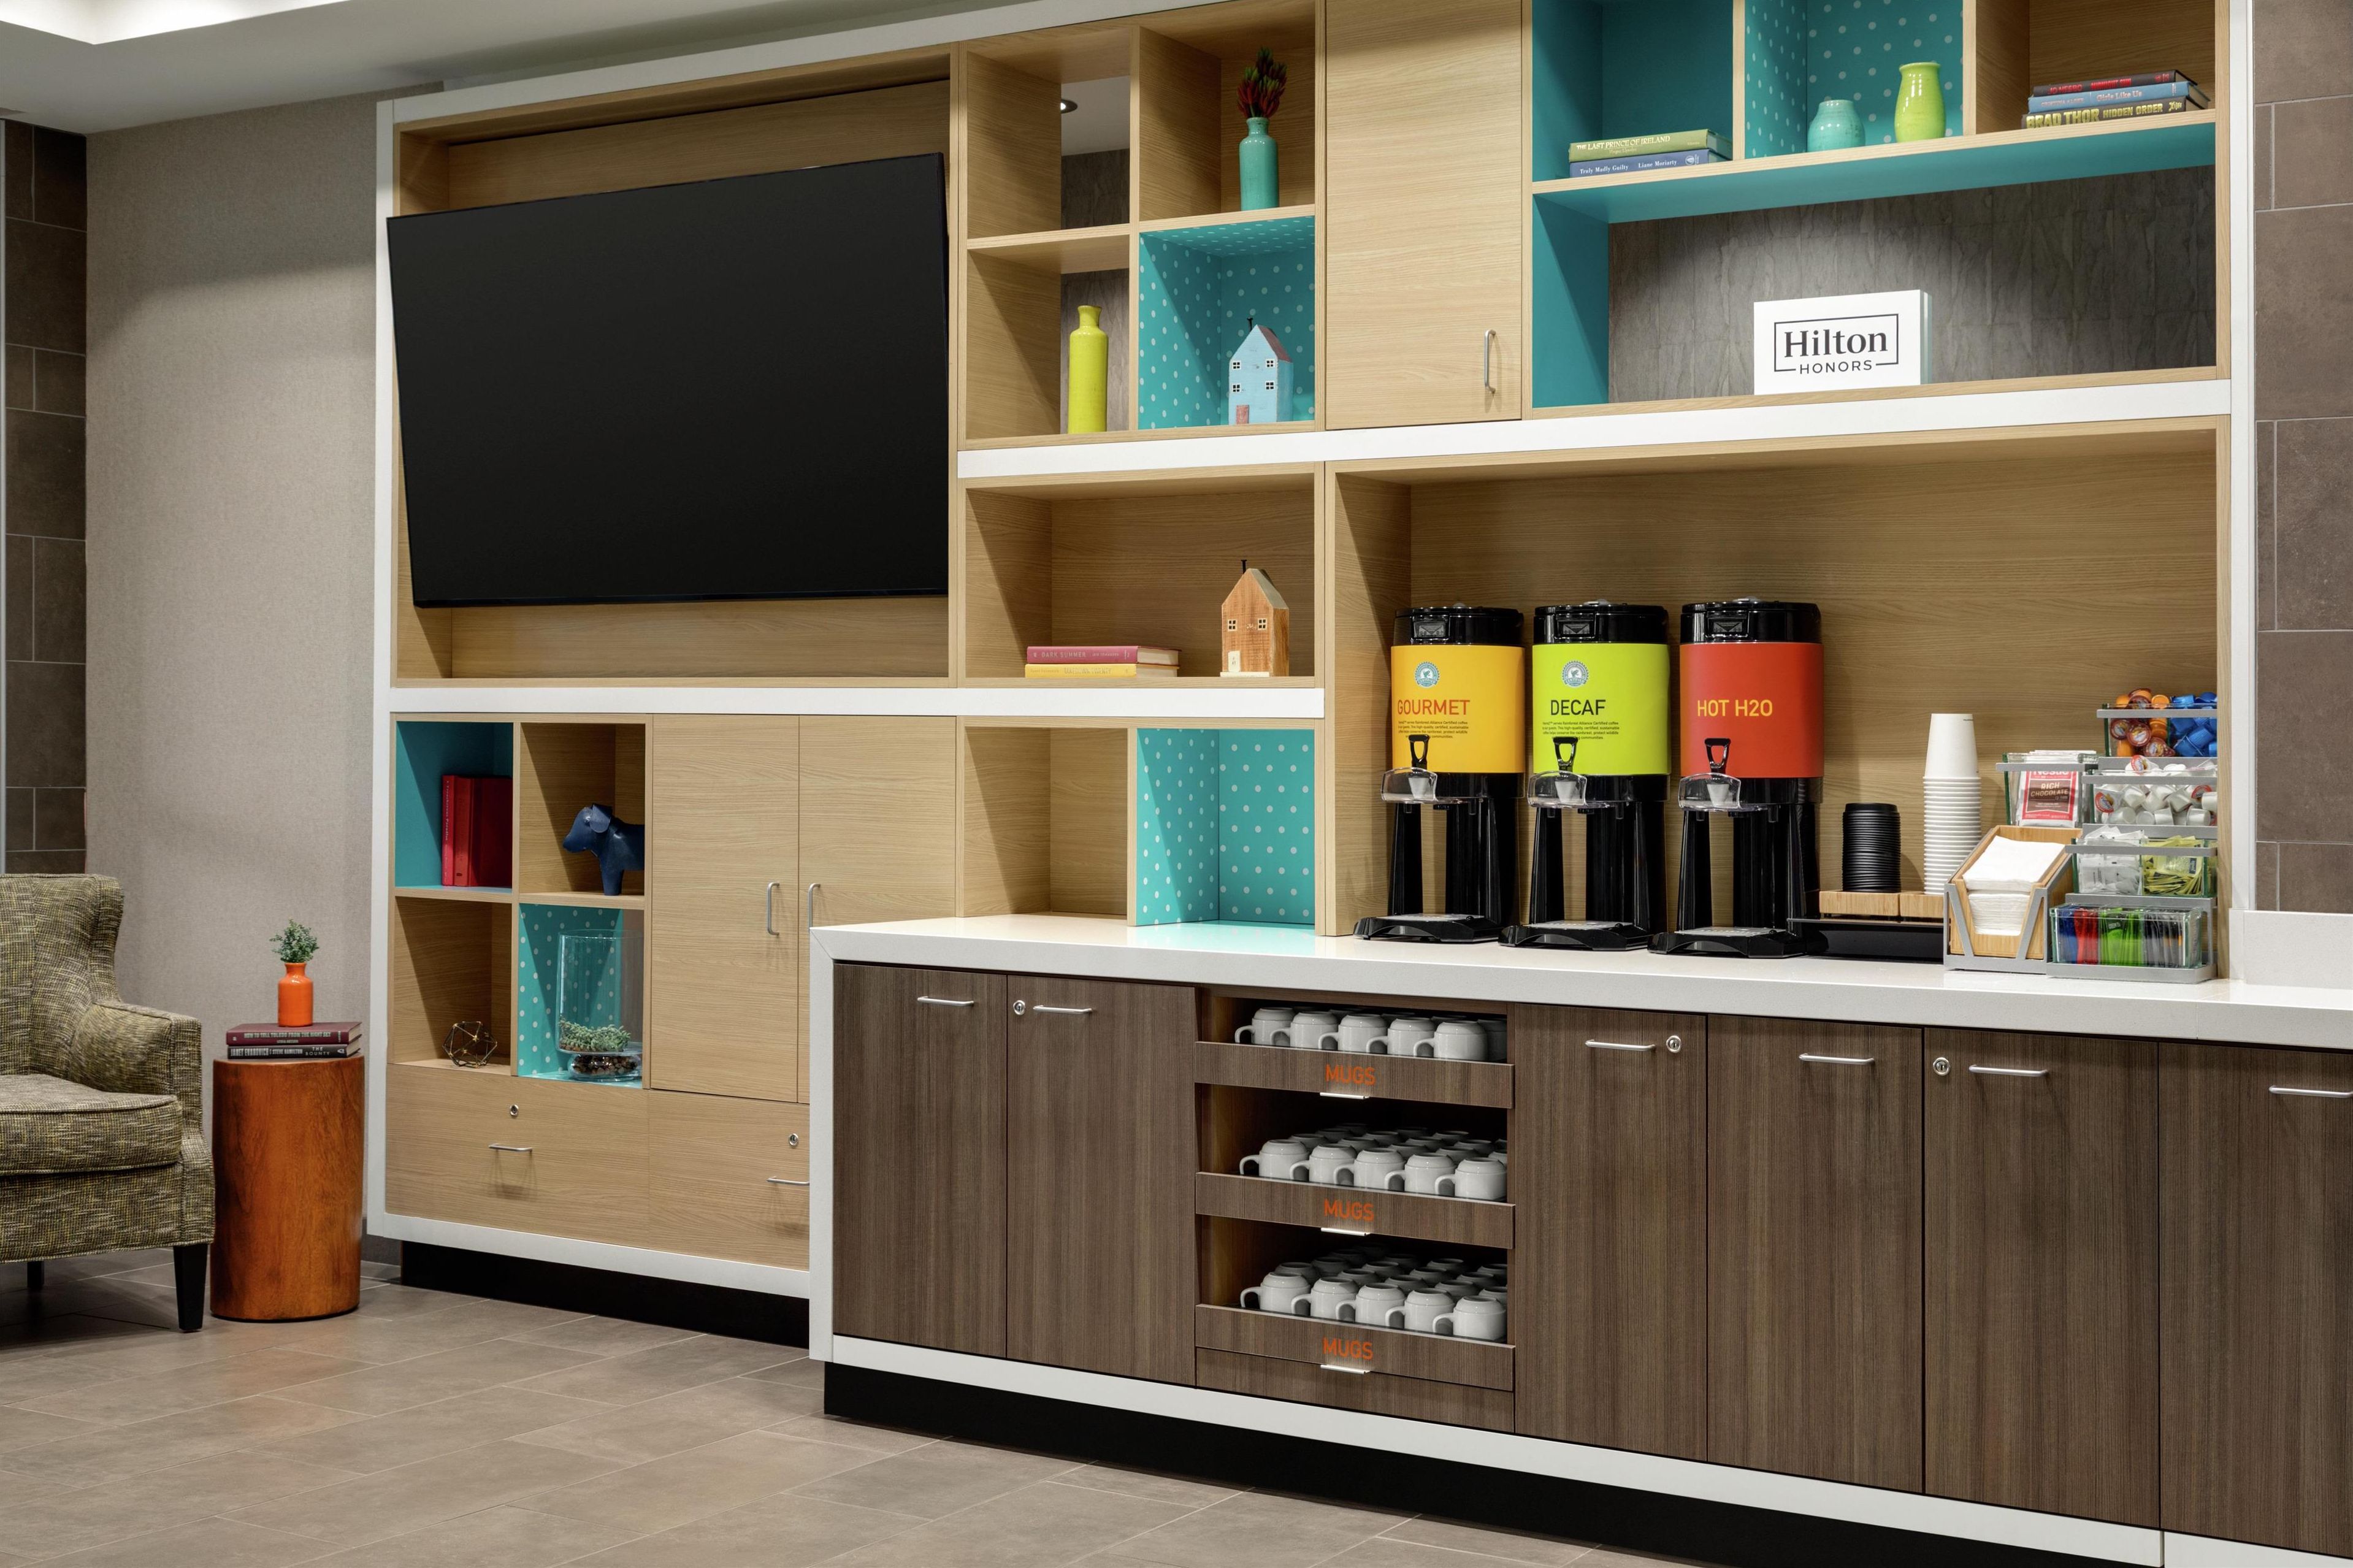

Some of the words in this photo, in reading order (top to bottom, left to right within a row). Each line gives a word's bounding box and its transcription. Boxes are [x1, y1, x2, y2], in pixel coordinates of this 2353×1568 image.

[2026, 113, 2062, 128] BRAD
[2064, 109, 2100, 125] THOR
[2103, 107, 2133, 118] HIDDEN
[2136, 103, 2163, 115] ORDER
[1605, 140, 1629, 150] PRINCE
[1641, 136, 1670, 145] IRELAND
[1784, 329, 1888, 358] Hilton
[1799, 359, 1872, 375] HONORS
[1398, 699, 1471, 716] GOURMET
[1550, 699, 1606, 716] DECAF
[1697, 700, 1729, 716] HOT
[1735, 700, 1773, 717] H2O
[2030, 789, 2069, 797] CHOCOLATE
[1325, 1064, 1376, 1086] MUGS
[1324, 1198, 1374, 1222] MUGS
[1322, 1336, 1374, 1360] MUGS
